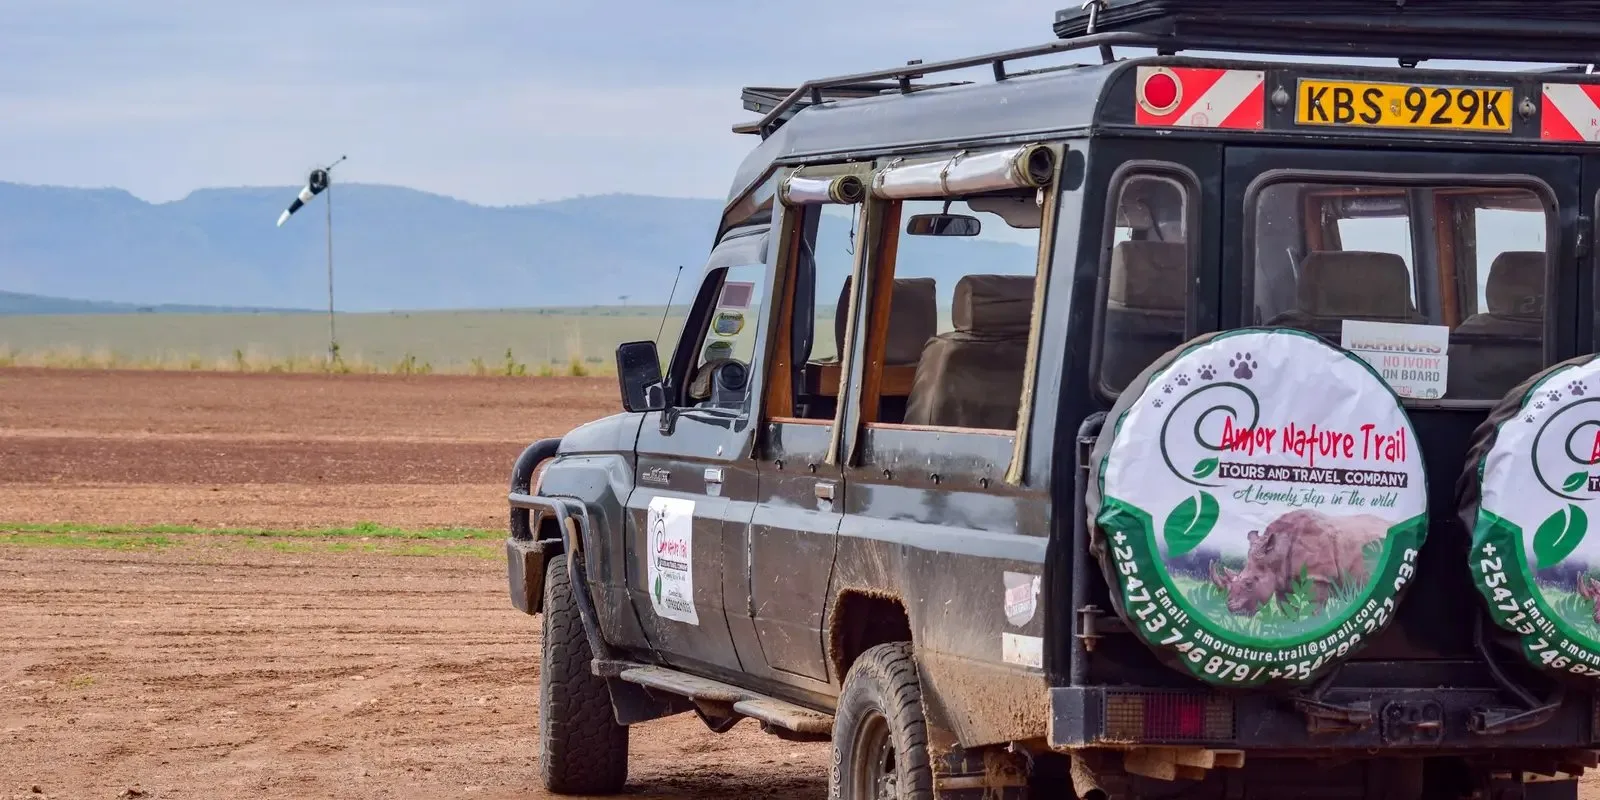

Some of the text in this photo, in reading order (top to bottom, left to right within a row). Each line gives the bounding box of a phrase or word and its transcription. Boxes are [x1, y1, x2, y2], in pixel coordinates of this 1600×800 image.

[1306, 86, 1506, 127] KBS 929K
[1382, 369, 1440, 382] ON BOARD
[1383, 355, 1441, 370] NO IVORY
[1220, 415, 1406, 467] Amor Nature Trail
[1221, 464, 1406, 487] TOURS AND TRAVEL COMPANY
[1253, 485, 1300, 507] homely
[1301, 488, 1325, 508] step
[1343, 489, 1365, 506] the
[1370, 491, 1398, 508] wild
[1113, 531, 1167, 633] +254713
[1204, 655, 1250, 682] 879
[1154, 587, 1378, 662] Email: amornature.trail@gmail.com
[1523, 597, 1556, 638] Email:
[1528, 637, 1571, 668] 746
